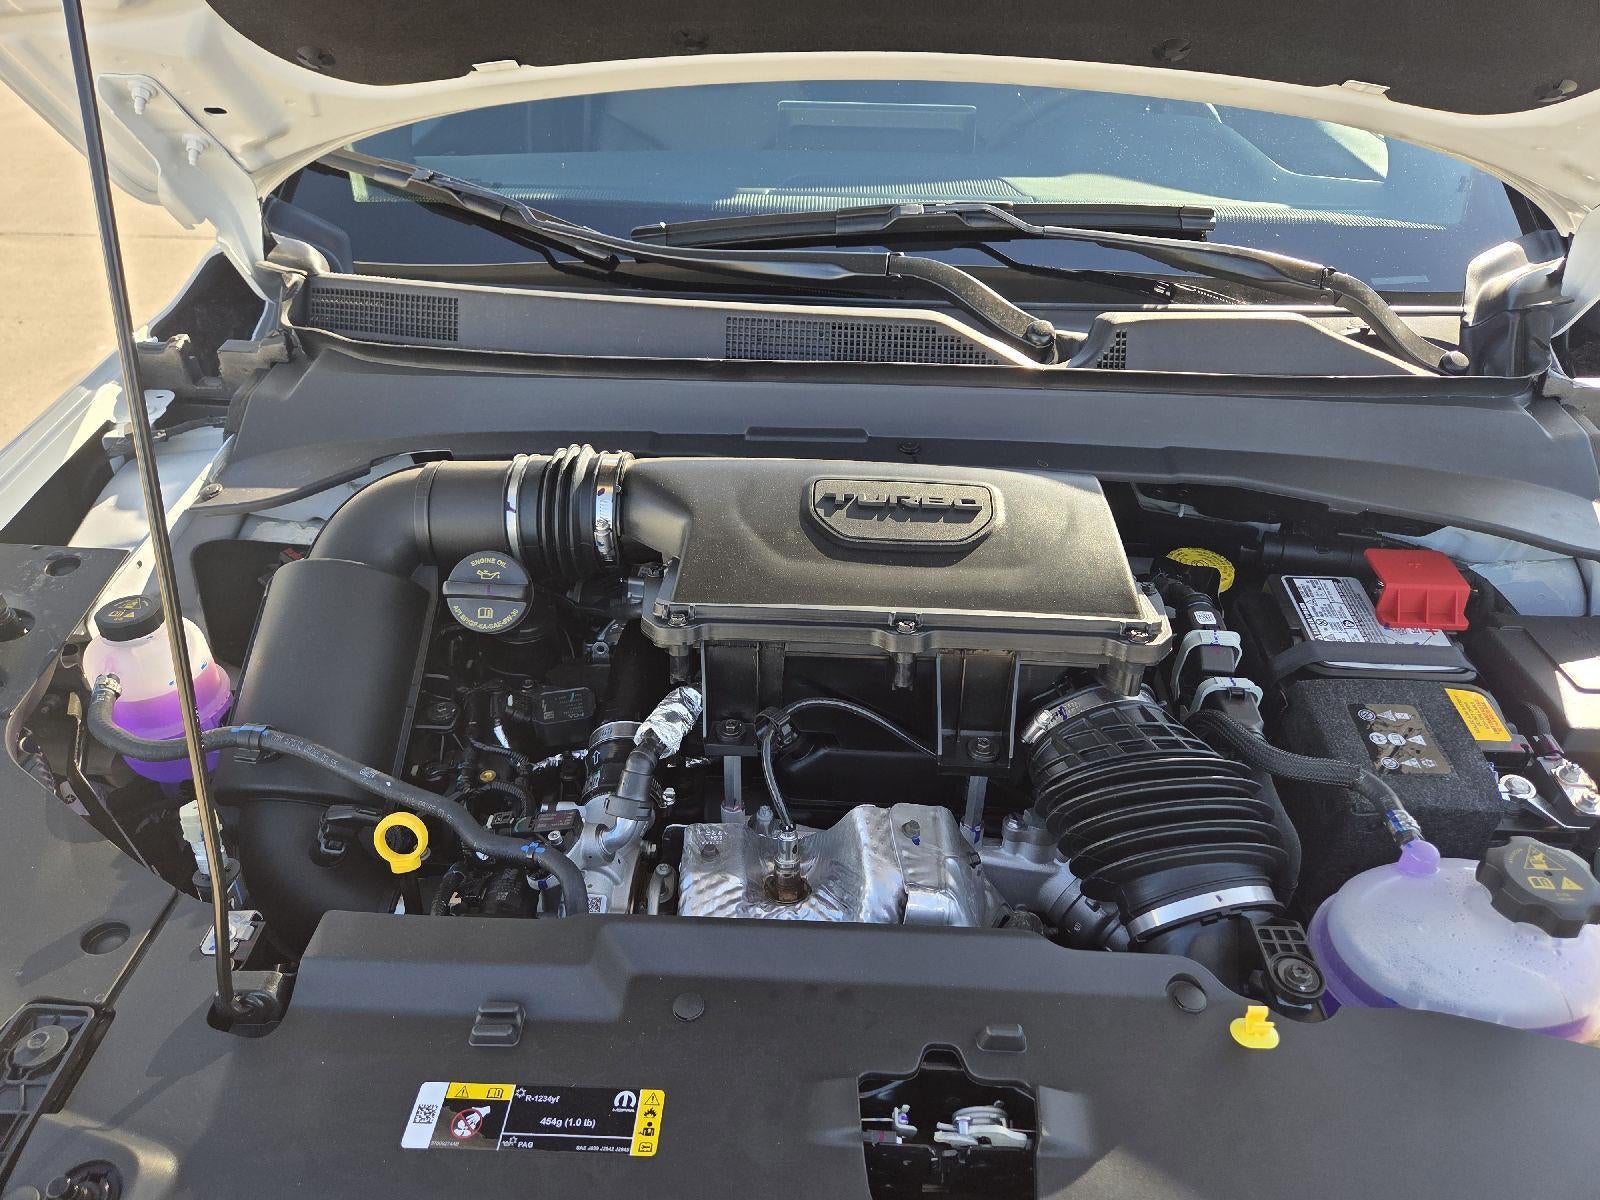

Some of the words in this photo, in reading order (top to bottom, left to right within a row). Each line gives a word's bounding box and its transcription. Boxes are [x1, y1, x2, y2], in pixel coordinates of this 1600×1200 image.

[816, 492, 983, 519] TURBO
[470, 557, 497, 567] ENGINE
[497, 560, 507, 569] OIL
[525, 1095, 561, 1104] R-1234yf
[540, 1117, 563, 1128] 454g
[565, 1117, 582, 1129] (1.0
[584, 1118, 596, 1129] lb)
